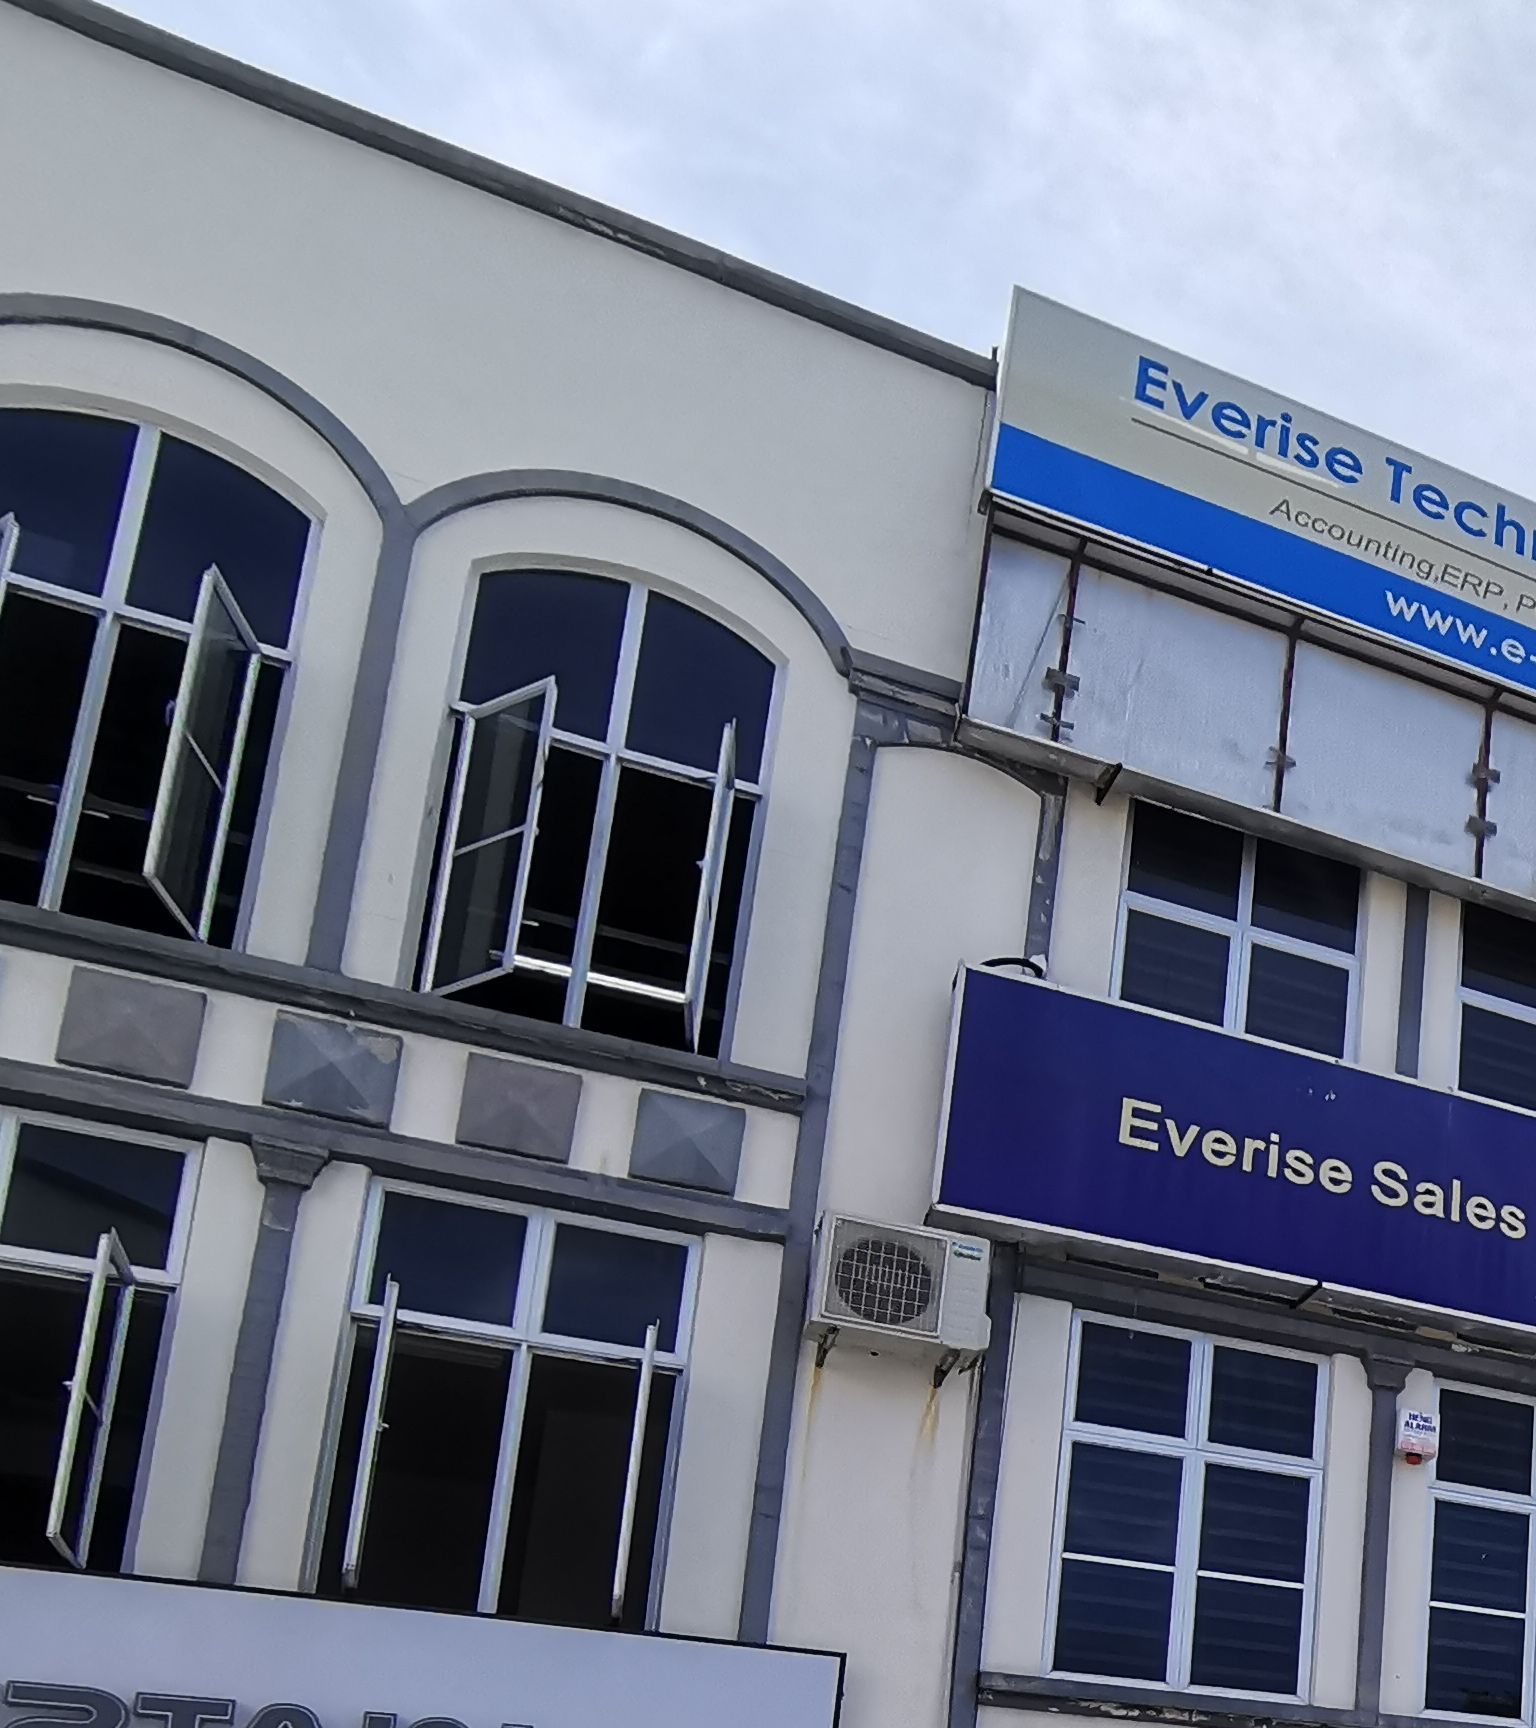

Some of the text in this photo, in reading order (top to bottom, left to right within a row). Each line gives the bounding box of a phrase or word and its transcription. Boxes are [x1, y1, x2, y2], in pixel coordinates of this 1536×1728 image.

[1134, 355, 1363, 484] Everise
[1118, 1096, 1353, 1195] Everise
[1371, 1160, 1527, 1240] Sales
